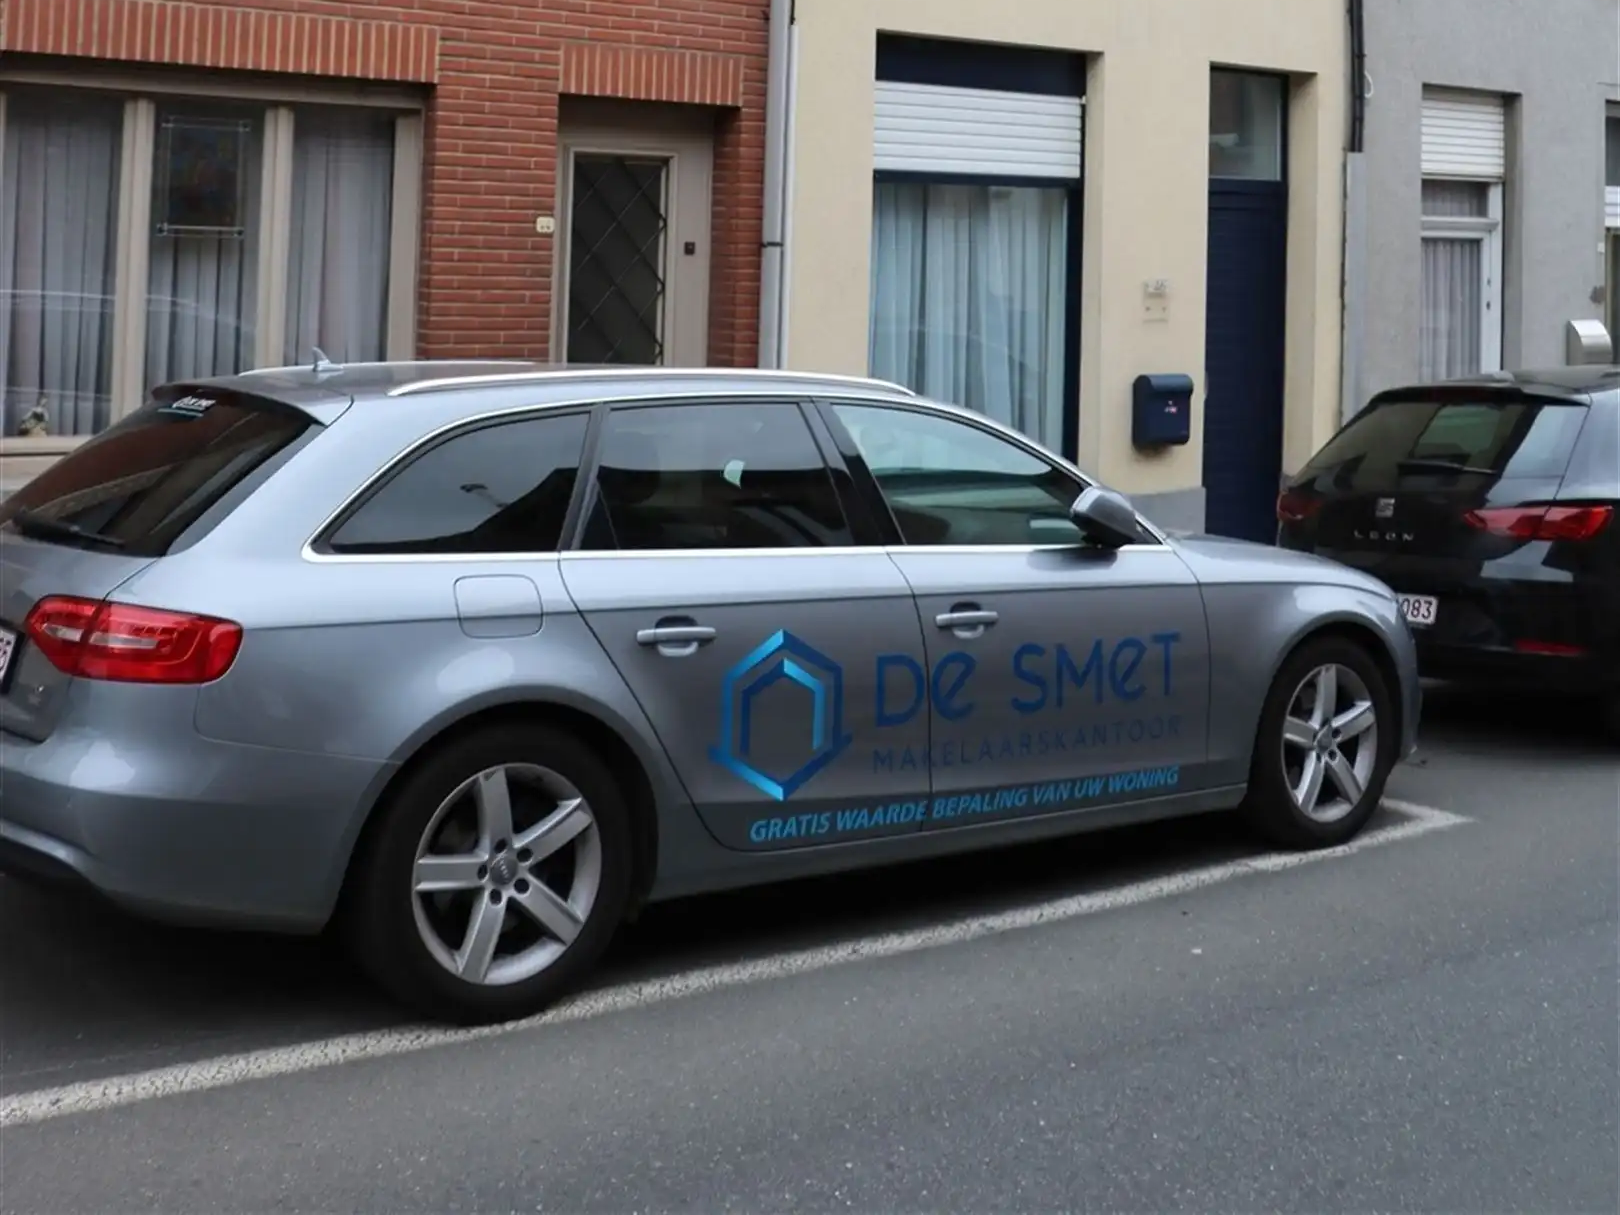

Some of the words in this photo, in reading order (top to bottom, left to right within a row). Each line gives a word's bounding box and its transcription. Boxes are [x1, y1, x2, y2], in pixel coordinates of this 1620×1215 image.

[1353, 529, 1414, 542] LEON
[872, 715, 1183, 773] MAKELAARSKANTOOR
[749, 810, 830, 843] GRATIS
[836, 800, 927, 831] WAARDE
[932, 786, 1029, 819] BEPALING
[1032, 780, 1071, 805] VAN
[1074, 775, 1103, 797] UW
[1108, 766, 1180, 793] WONING
